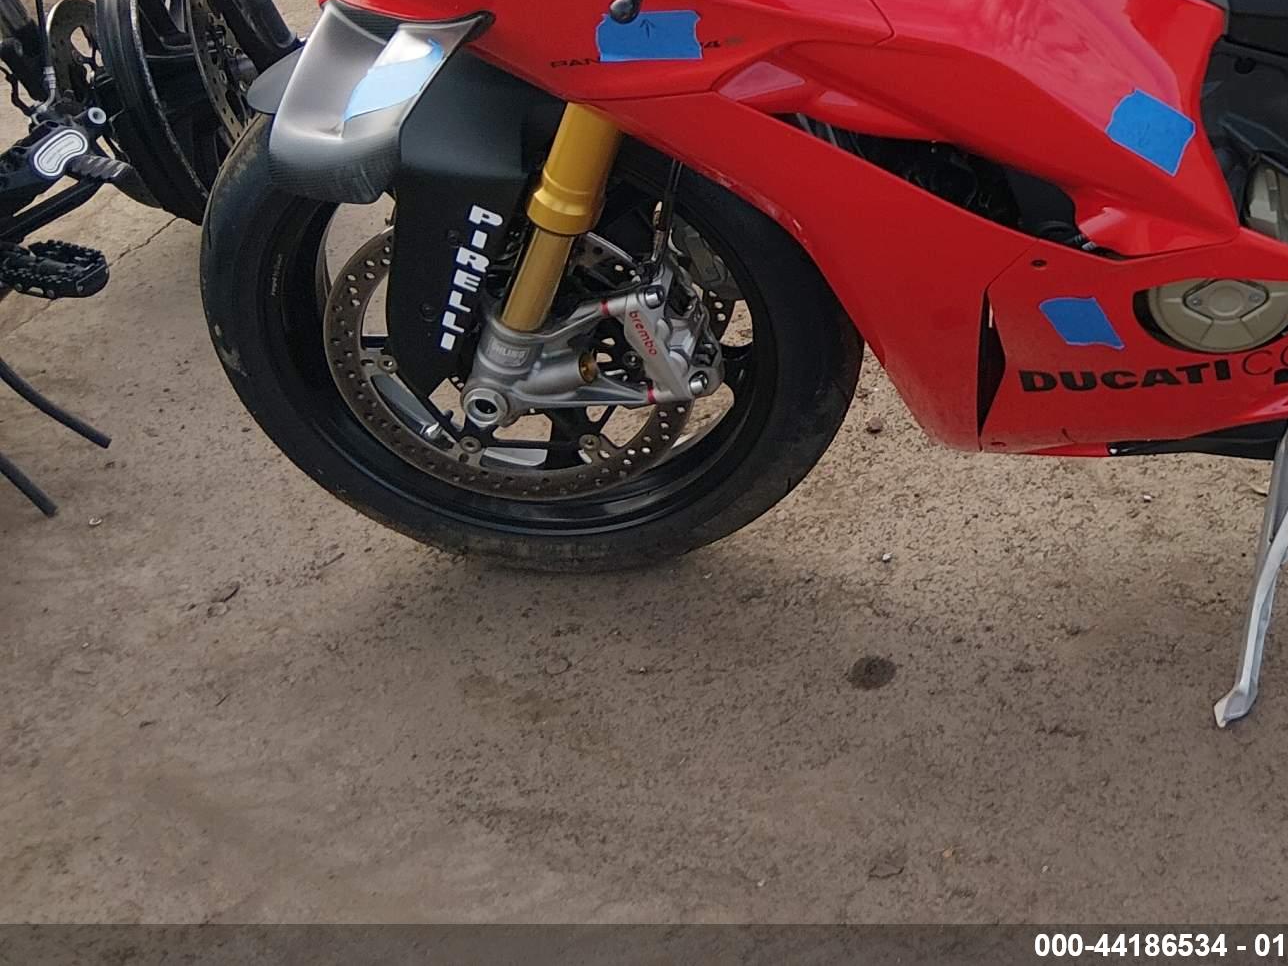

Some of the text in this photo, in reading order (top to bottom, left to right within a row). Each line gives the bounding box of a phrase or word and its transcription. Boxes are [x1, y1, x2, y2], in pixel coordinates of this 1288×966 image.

[439, 204, 504, 351] PIRELLI
[629, 310, 657, 357] brembo
[1019, 359, 1233, 393] DUCATI
